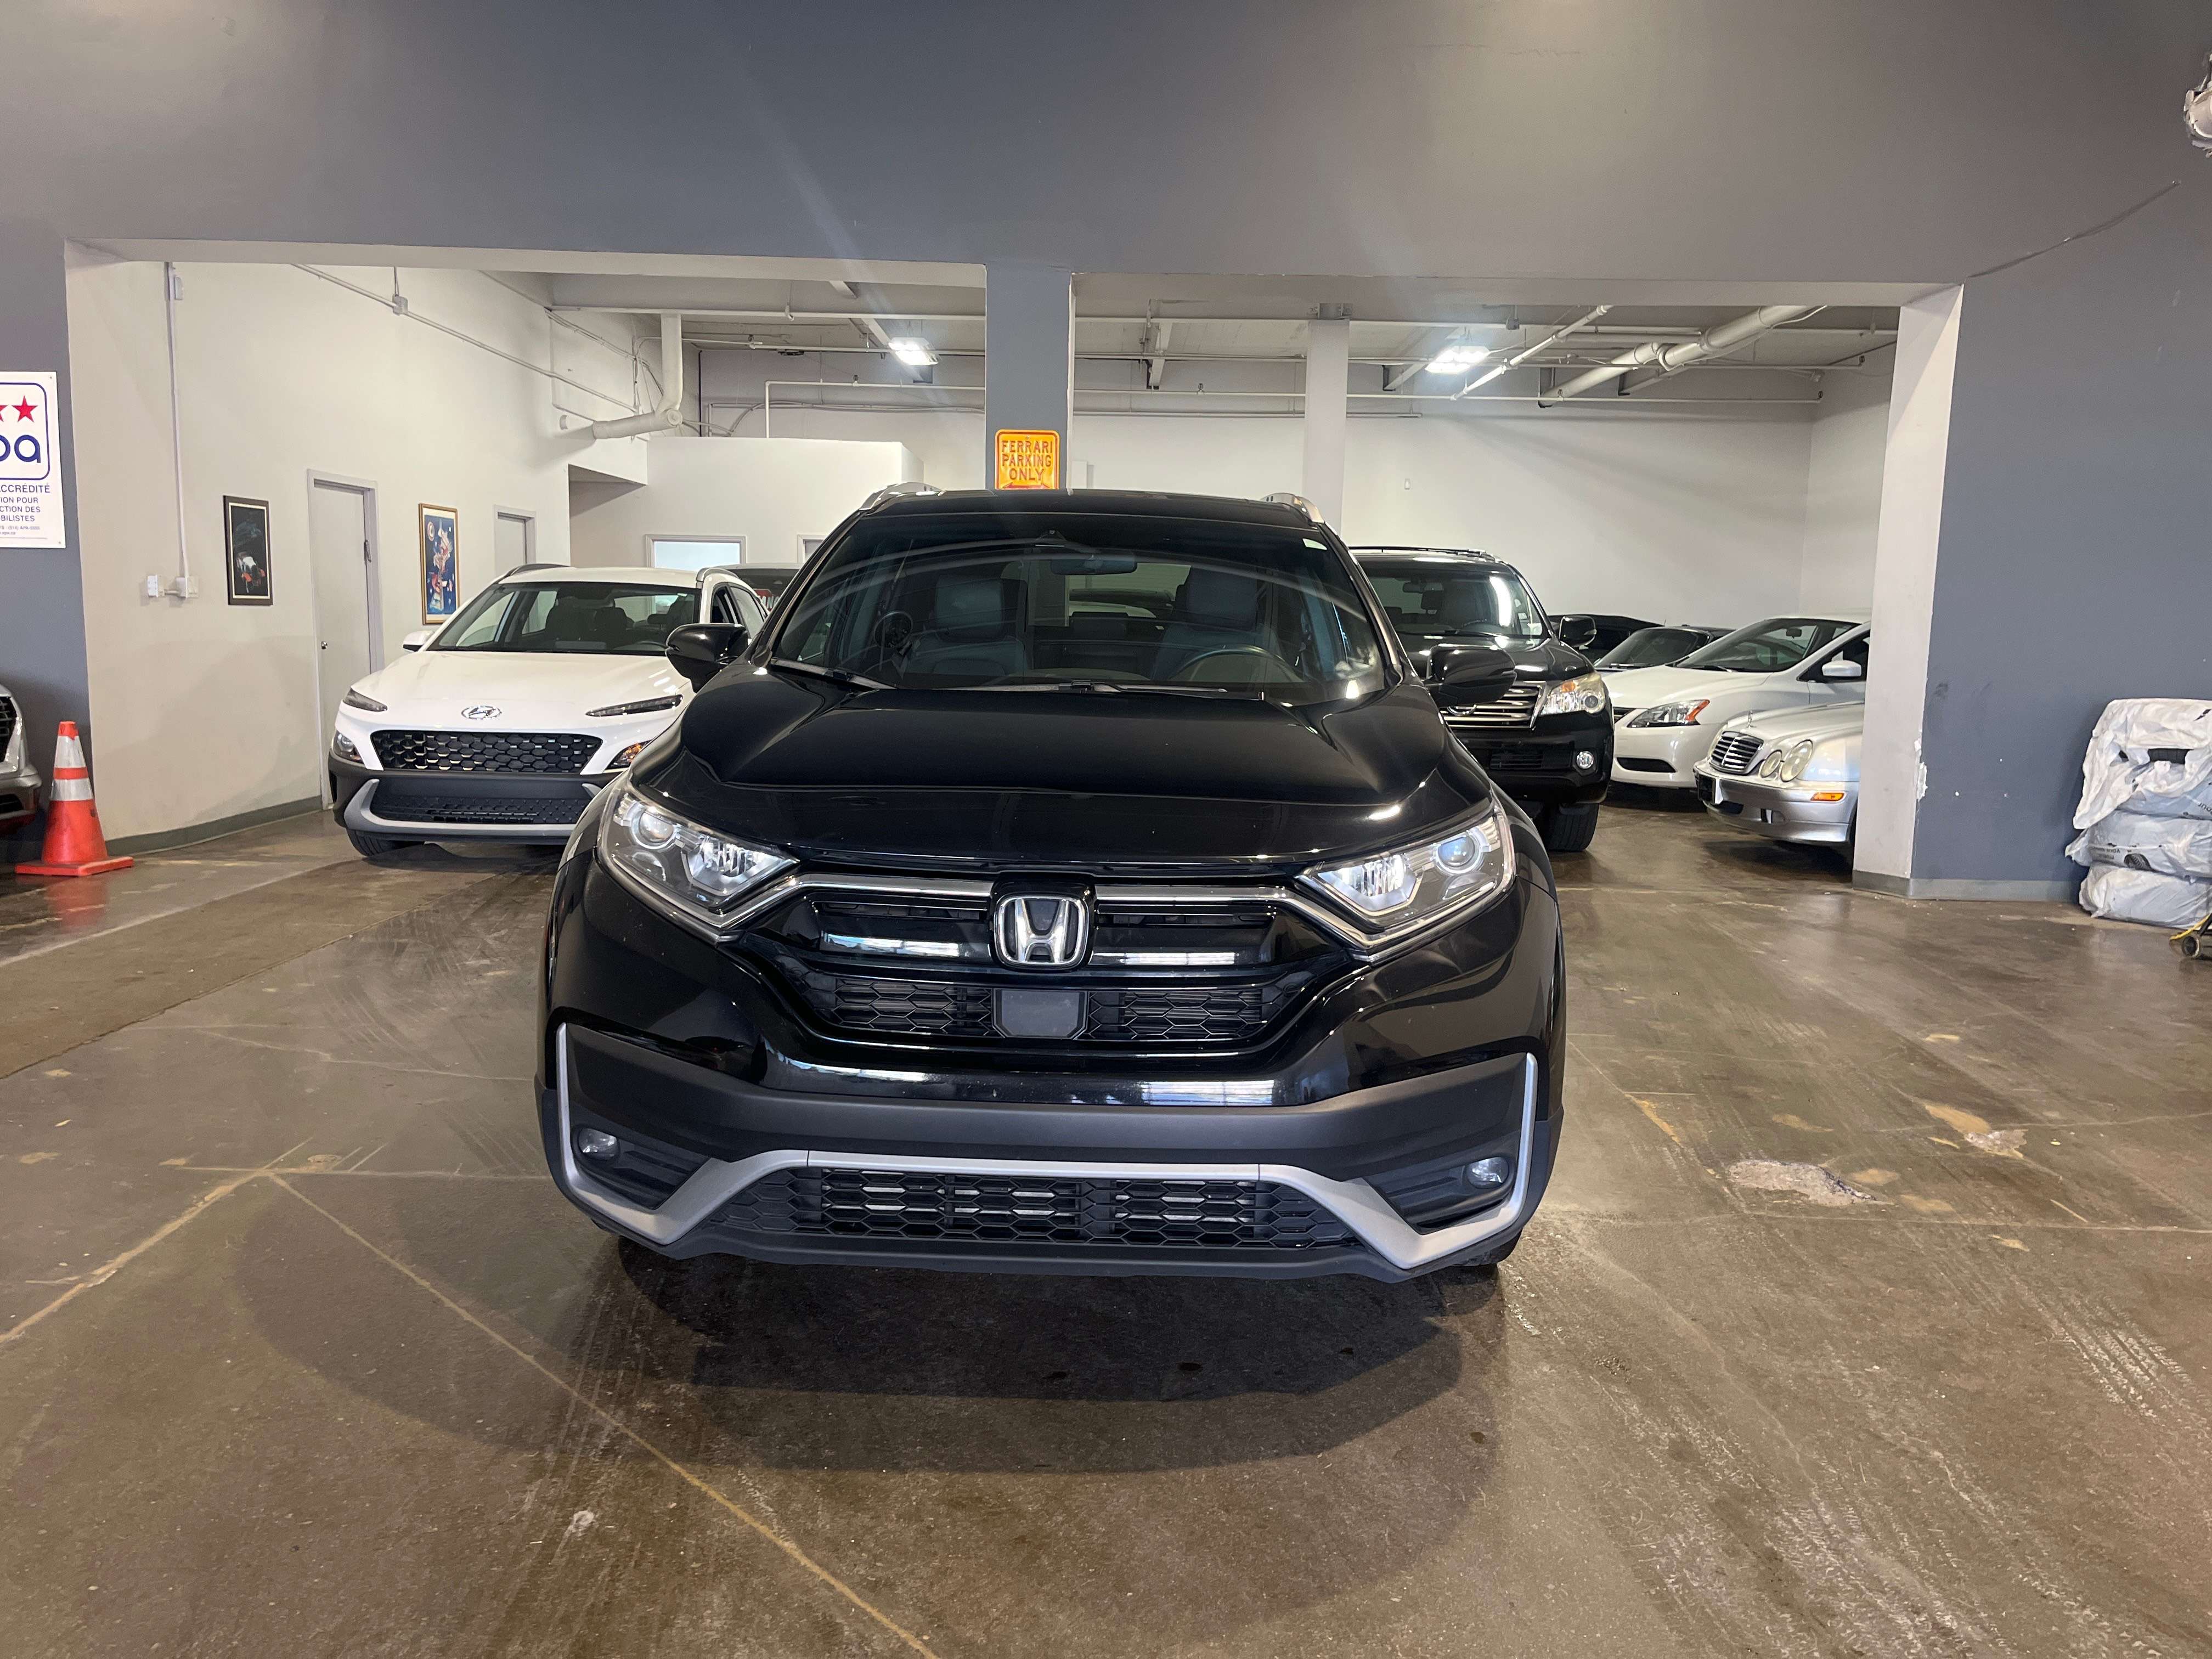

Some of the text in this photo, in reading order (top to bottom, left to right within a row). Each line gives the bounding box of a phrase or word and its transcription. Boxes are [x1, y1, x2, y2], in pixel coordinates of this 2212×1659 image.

[1001, 441, 1052, 453] FERRARI
[1002, 454, 1052, 467] PARKING
[1009, 468, 1045, 481] ONLY
[0, 482, 50, 493] CCRÉDITÉ
